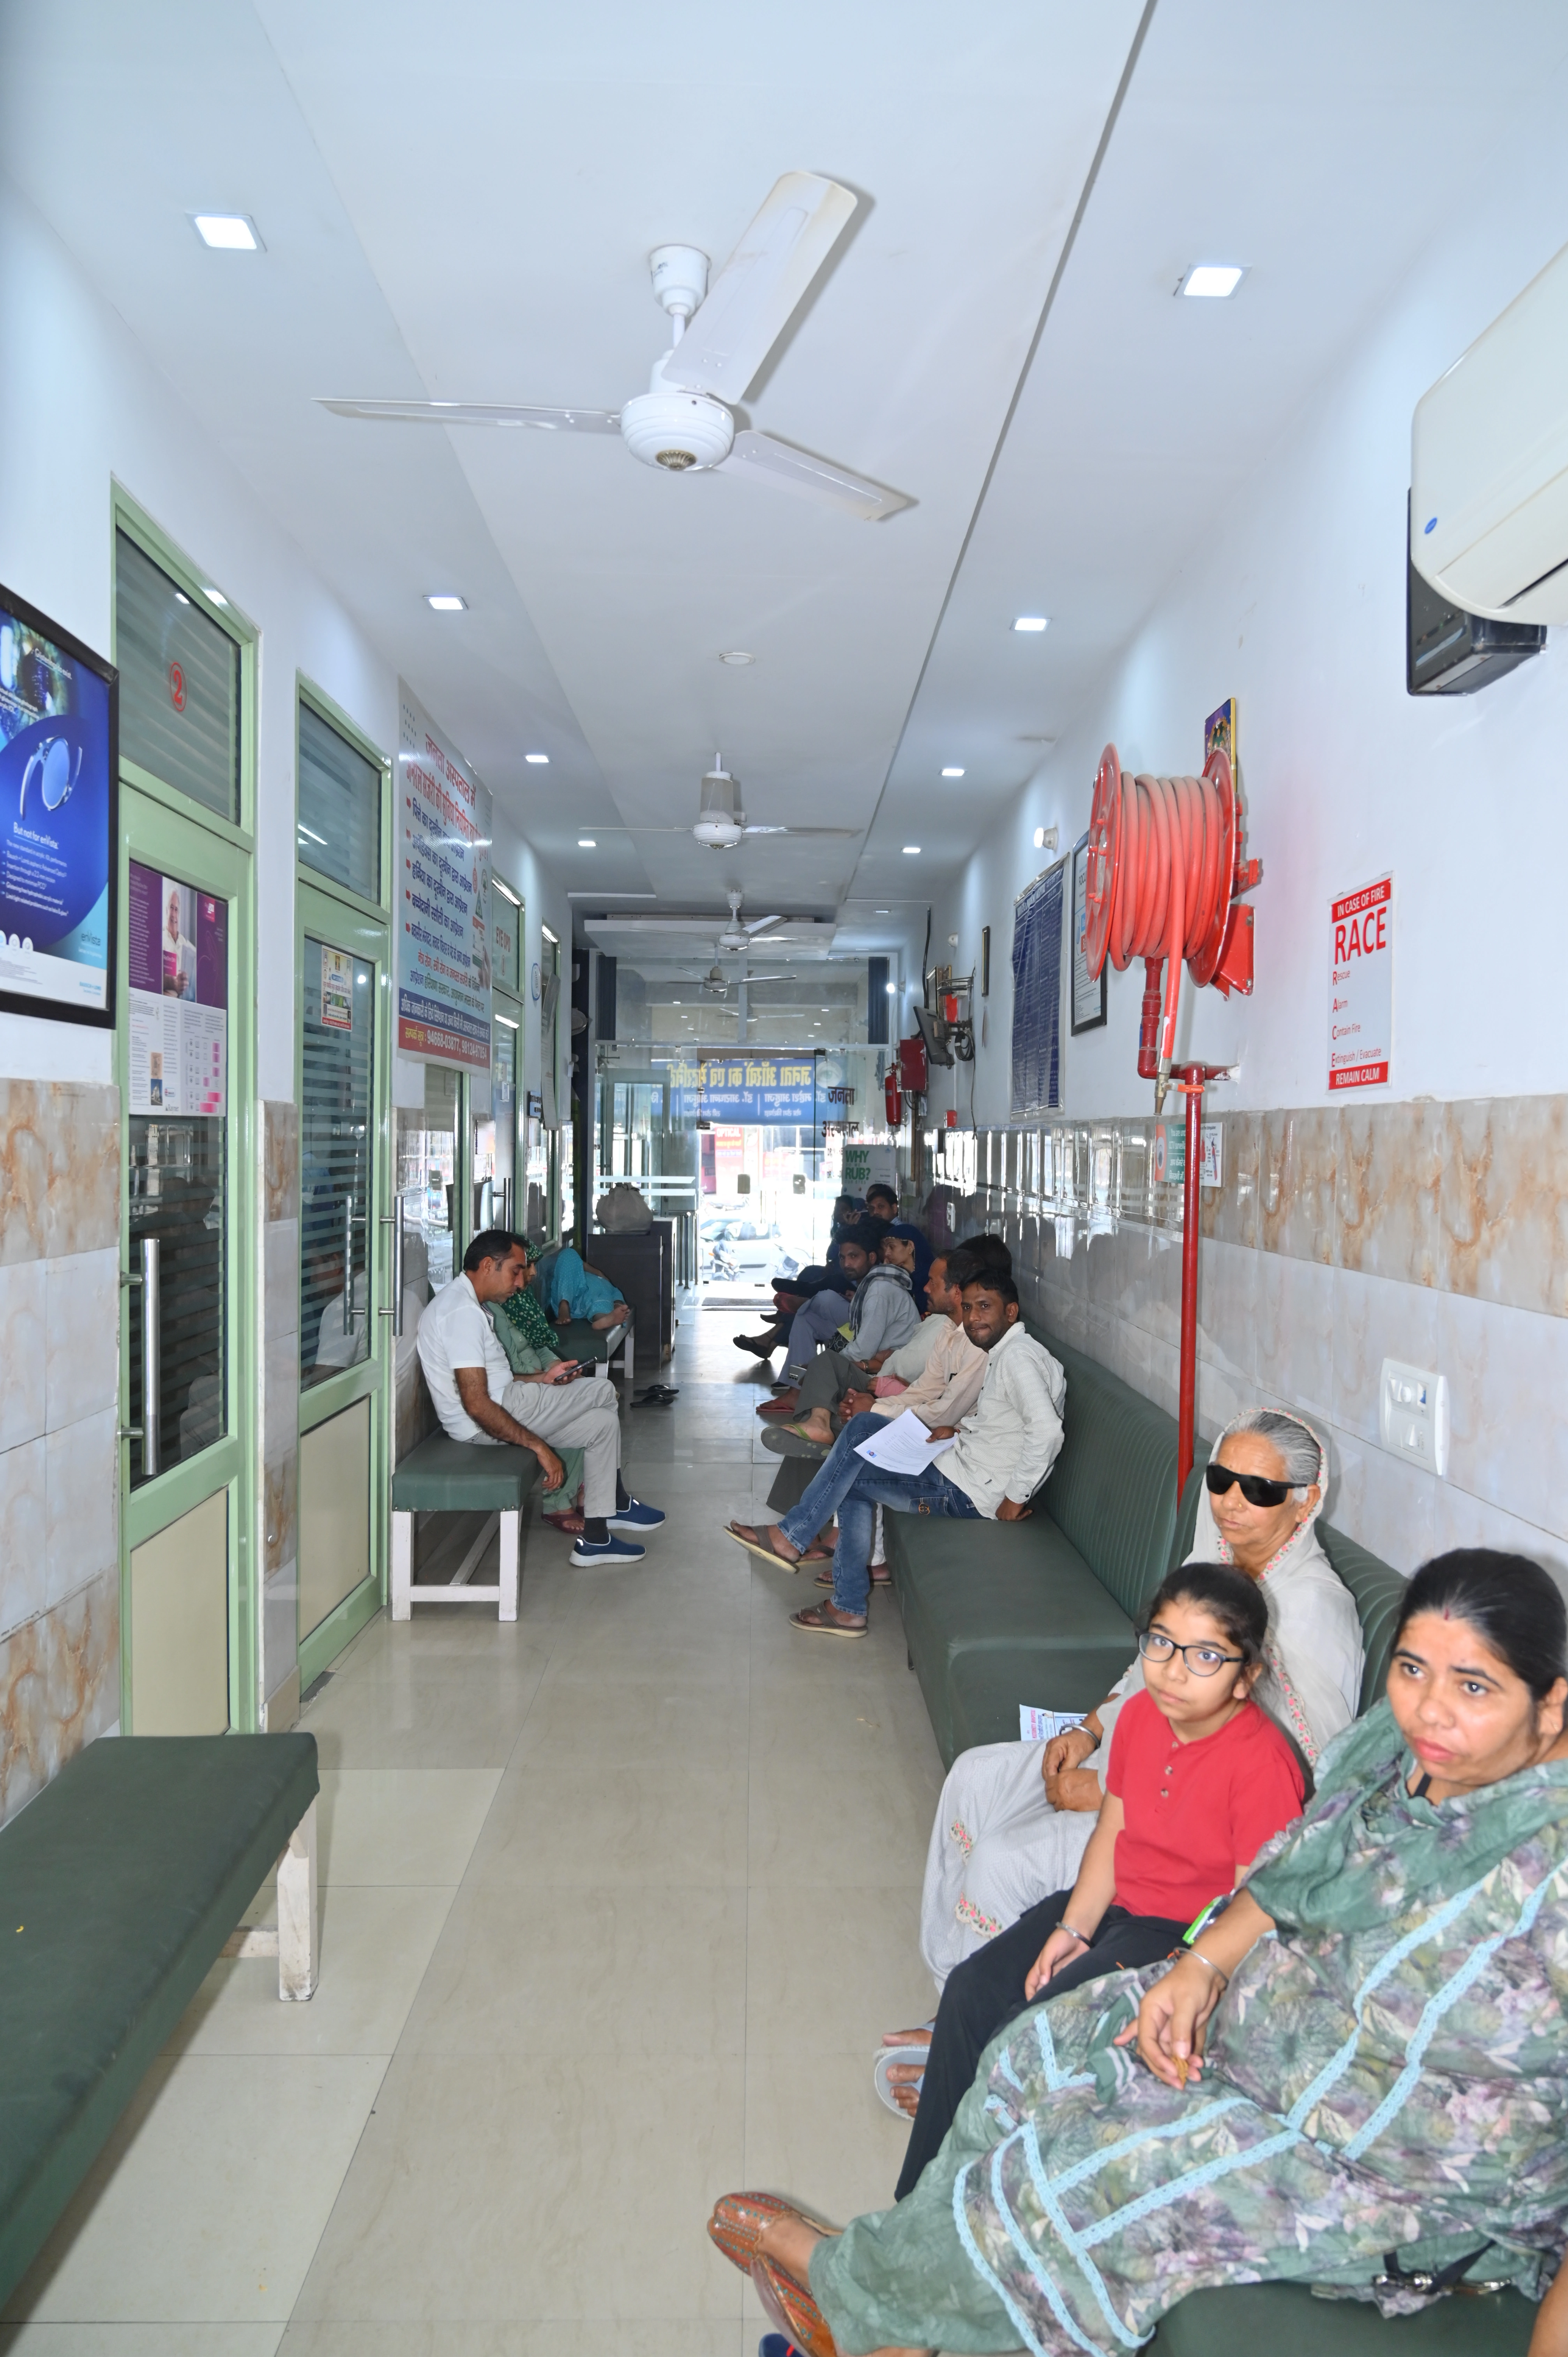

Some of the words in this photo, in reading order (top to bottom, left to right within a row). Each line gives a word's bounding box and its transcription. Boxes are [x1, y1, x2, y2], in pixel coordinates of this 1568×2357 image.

[174, 670, 182, 705] 2
[426, 733, 445, 775] जनता
[445, 759, 470, 804] अस्पताल
[412, 797, 421, 823] पित्ते
[422, 811, 428, 829] का
[423, 772, 435, 807] सर्जरी
[435, 783, 442, 813] की
[442, 791, 455, 826] सुविधा
[455, 800, 469, 843] नियमित
[13, 821, 23, 835] But
[432, 850, 438, 867] का
[438, 856, 451, 878] दूरबीन
[459, 873, 472, 895] आप्रेशन
[412, 860, 426, 885] हर्निया
[426, 874, 433, 891] का
[433, 878, 446, 901] दूरबीन
[454, 894, 468, 916] आप्रेशन
[1337, 903, 1344, 917] IN
[1345, 896, 1360, 914] CASE
[1360, 891, 1370, 907] OF
[1370, 885, 1385, 903] FIRE
[412, 892, 431, 918] बच्चेदानी
[444, 914, 450, 930] का
[450, 918, 464, 939] आप्रेशन
[1335, 905, 1387, 965] RACE
[410, 968, 424, 986] आप्रेशन
[1333, 970, 1350, 986] Rescue
[401, 993, 411, 1013] अधिक
[1332, 998, 1348, 1013] Alarm
[1332, 1025, 1351, 1041] Contain
[1352, 1023, 1361, 1034] Fire
[427, 1029, 461, 1055] 94668-03877,
[461, 1039, 487, 1060] 98124-97854
[1331, 1051, 1355, 1067] Extinguish
[1360, 1047, 1381, 1060] Evacuate
[1335, 1070, 1360, 1085] REMAIN
[1361, 1067, 1380, 1082] CALM
[827, 1086, 855, 1106] जनता
[717, 1128, 741, 1138] OPTICAL
[846, 1150, 870, 1163] WHY
[845, 1167, 871, 1180] RUB?
